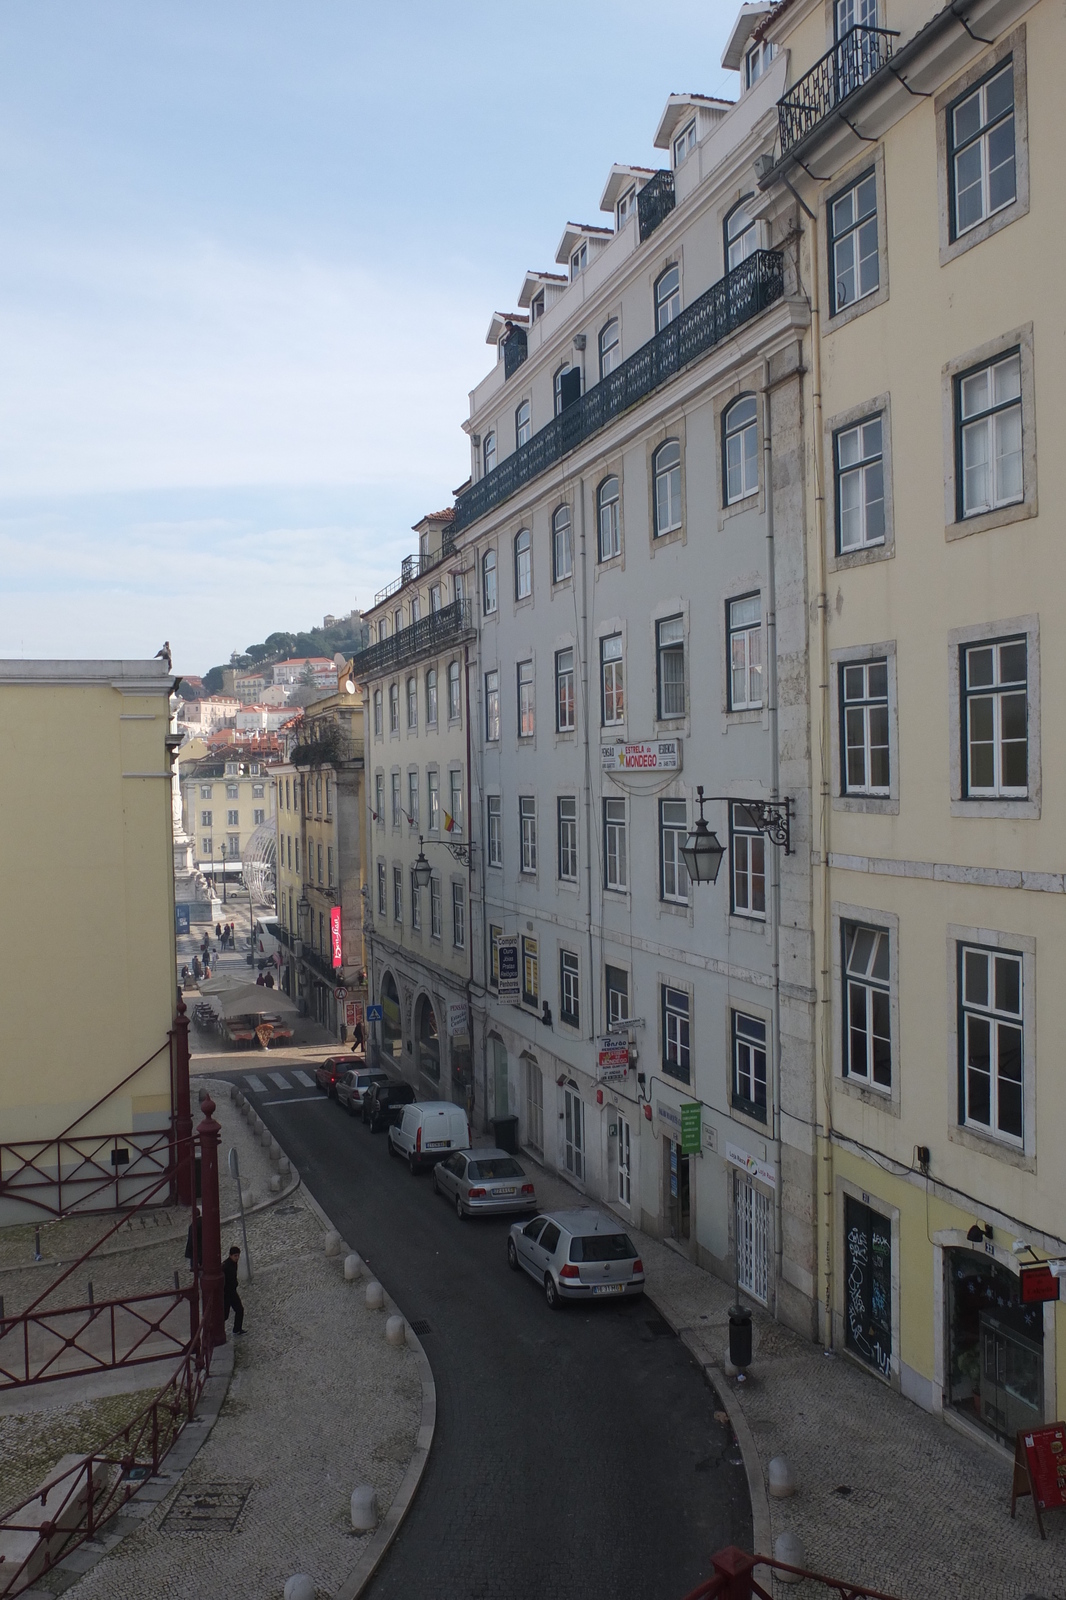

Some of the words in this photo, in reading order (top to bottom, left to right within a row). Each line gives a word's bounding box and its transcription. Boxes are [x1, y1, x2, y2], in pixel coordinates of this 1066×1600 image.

[626, 745, 644, 754] ESTRELA
[626, 754, 657, 768] MONDEGO
[498, 938, 518, 946] Compro
[500, 980, 519, 988] Penhores
[602, 1038, 627, 1047] Pensão
[602, 1057, 627, 1065] MONDEGO
